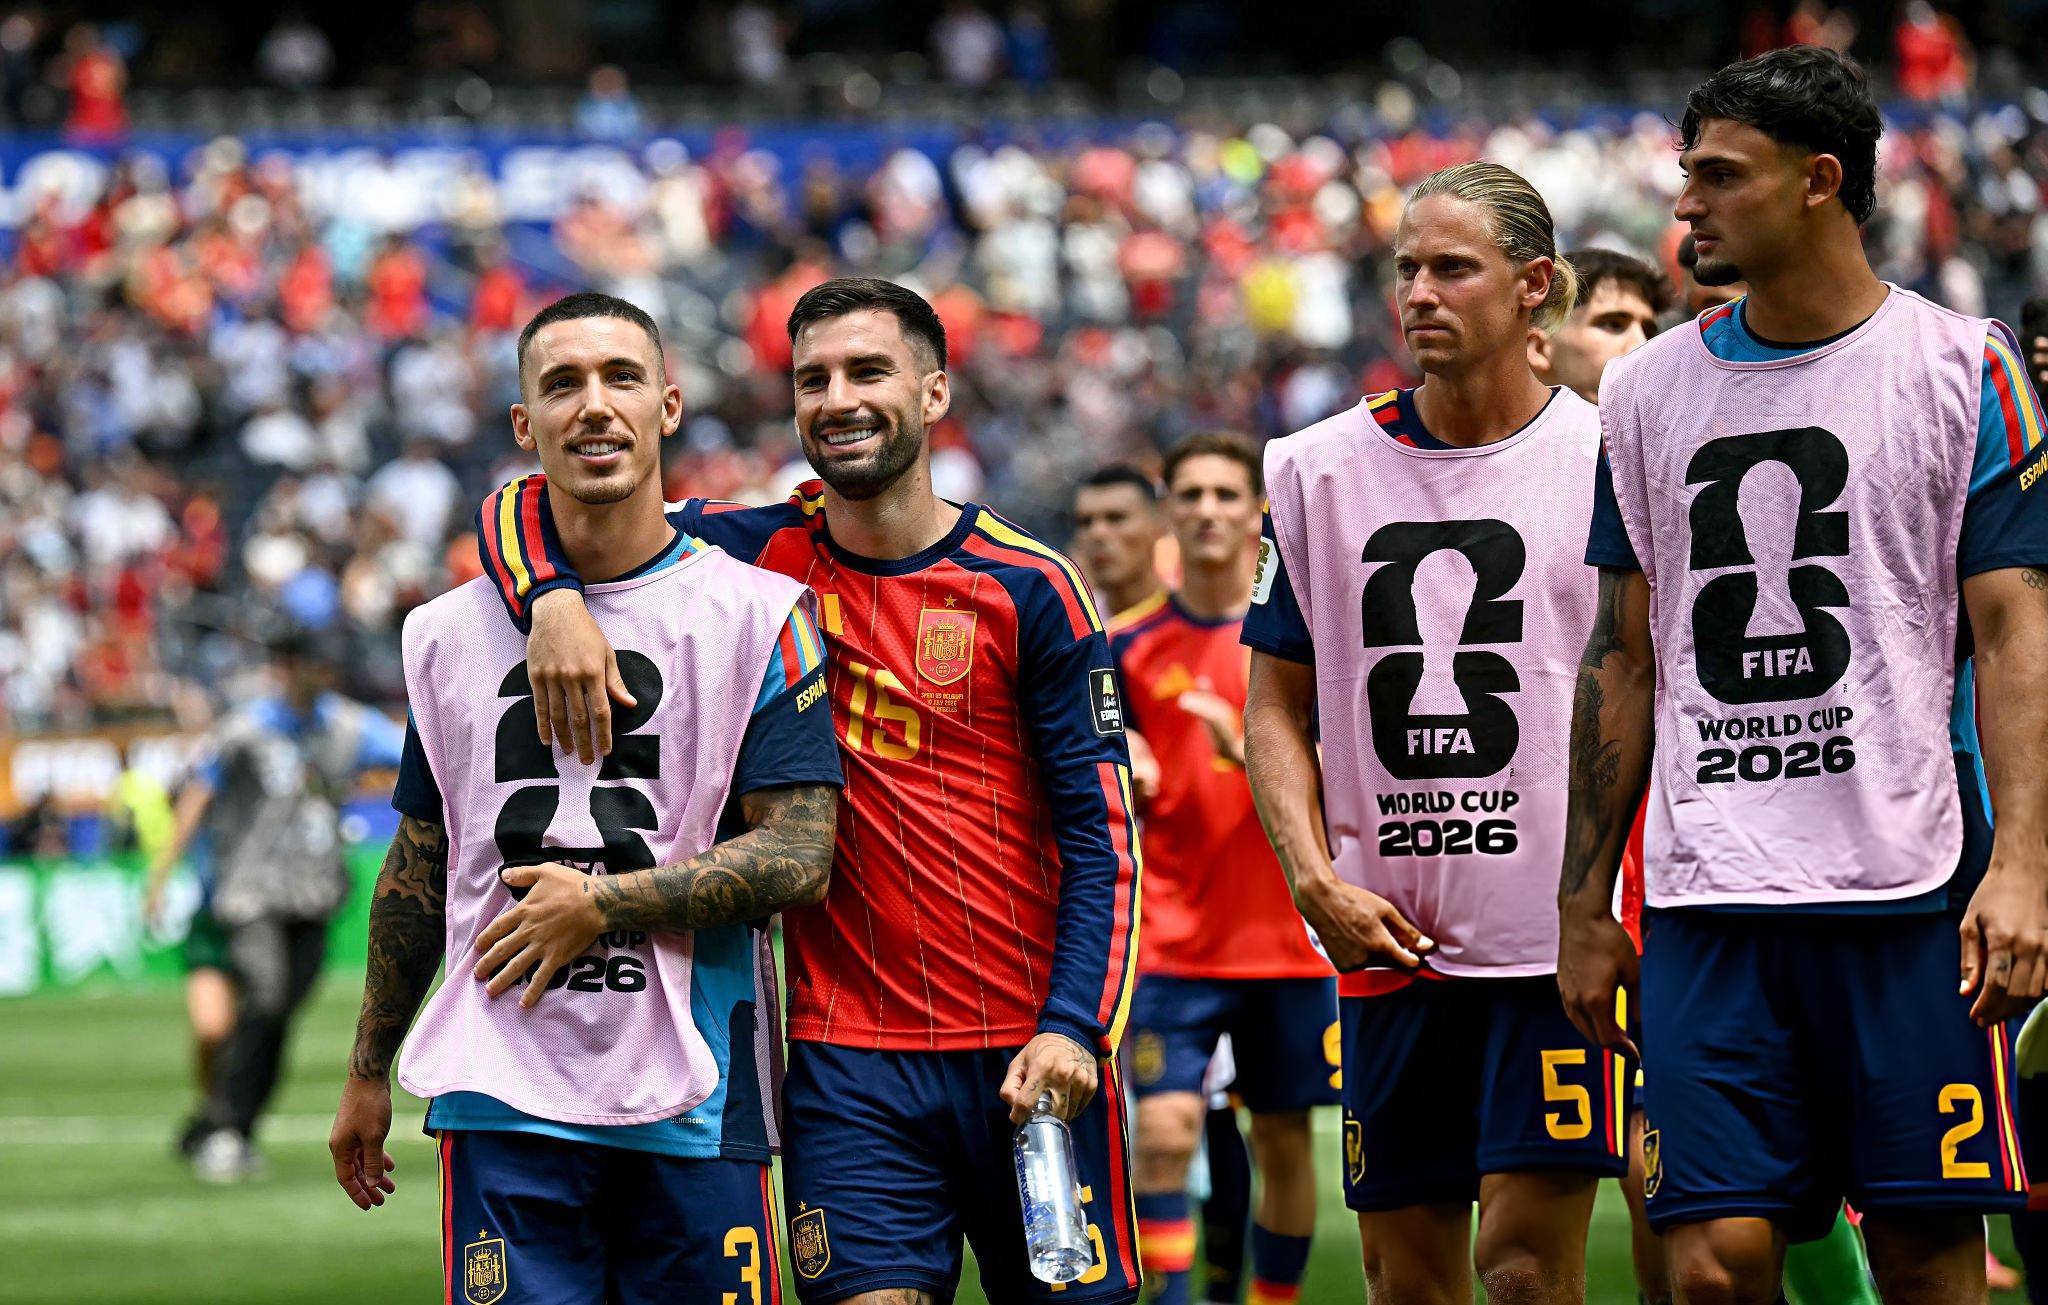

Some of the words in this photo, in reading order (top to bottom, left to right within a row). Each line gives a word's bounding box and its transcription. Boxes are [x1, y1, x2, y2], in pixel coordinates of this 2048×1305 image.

[1742, 647, 1814, 679] FIFA
[846, 660, 920, 760] 15
[1697, 713, 1802, 742] WORLD
[1808, 706, 1853, 733] CUP
[1407, 728, 1475, 755] FIFA
[1696, 736, 1856, 784] 2026
[1376, 790, 1455, 816] WORLD
[1461, 790, 1520, 813] CUP
[1378, 819, 1518, 857] 2026
[1541, 1048, 1592, 1140] 5
[1938, 1083, 1991, 1178] 2
[722, 1226, 762, 1305] 3
